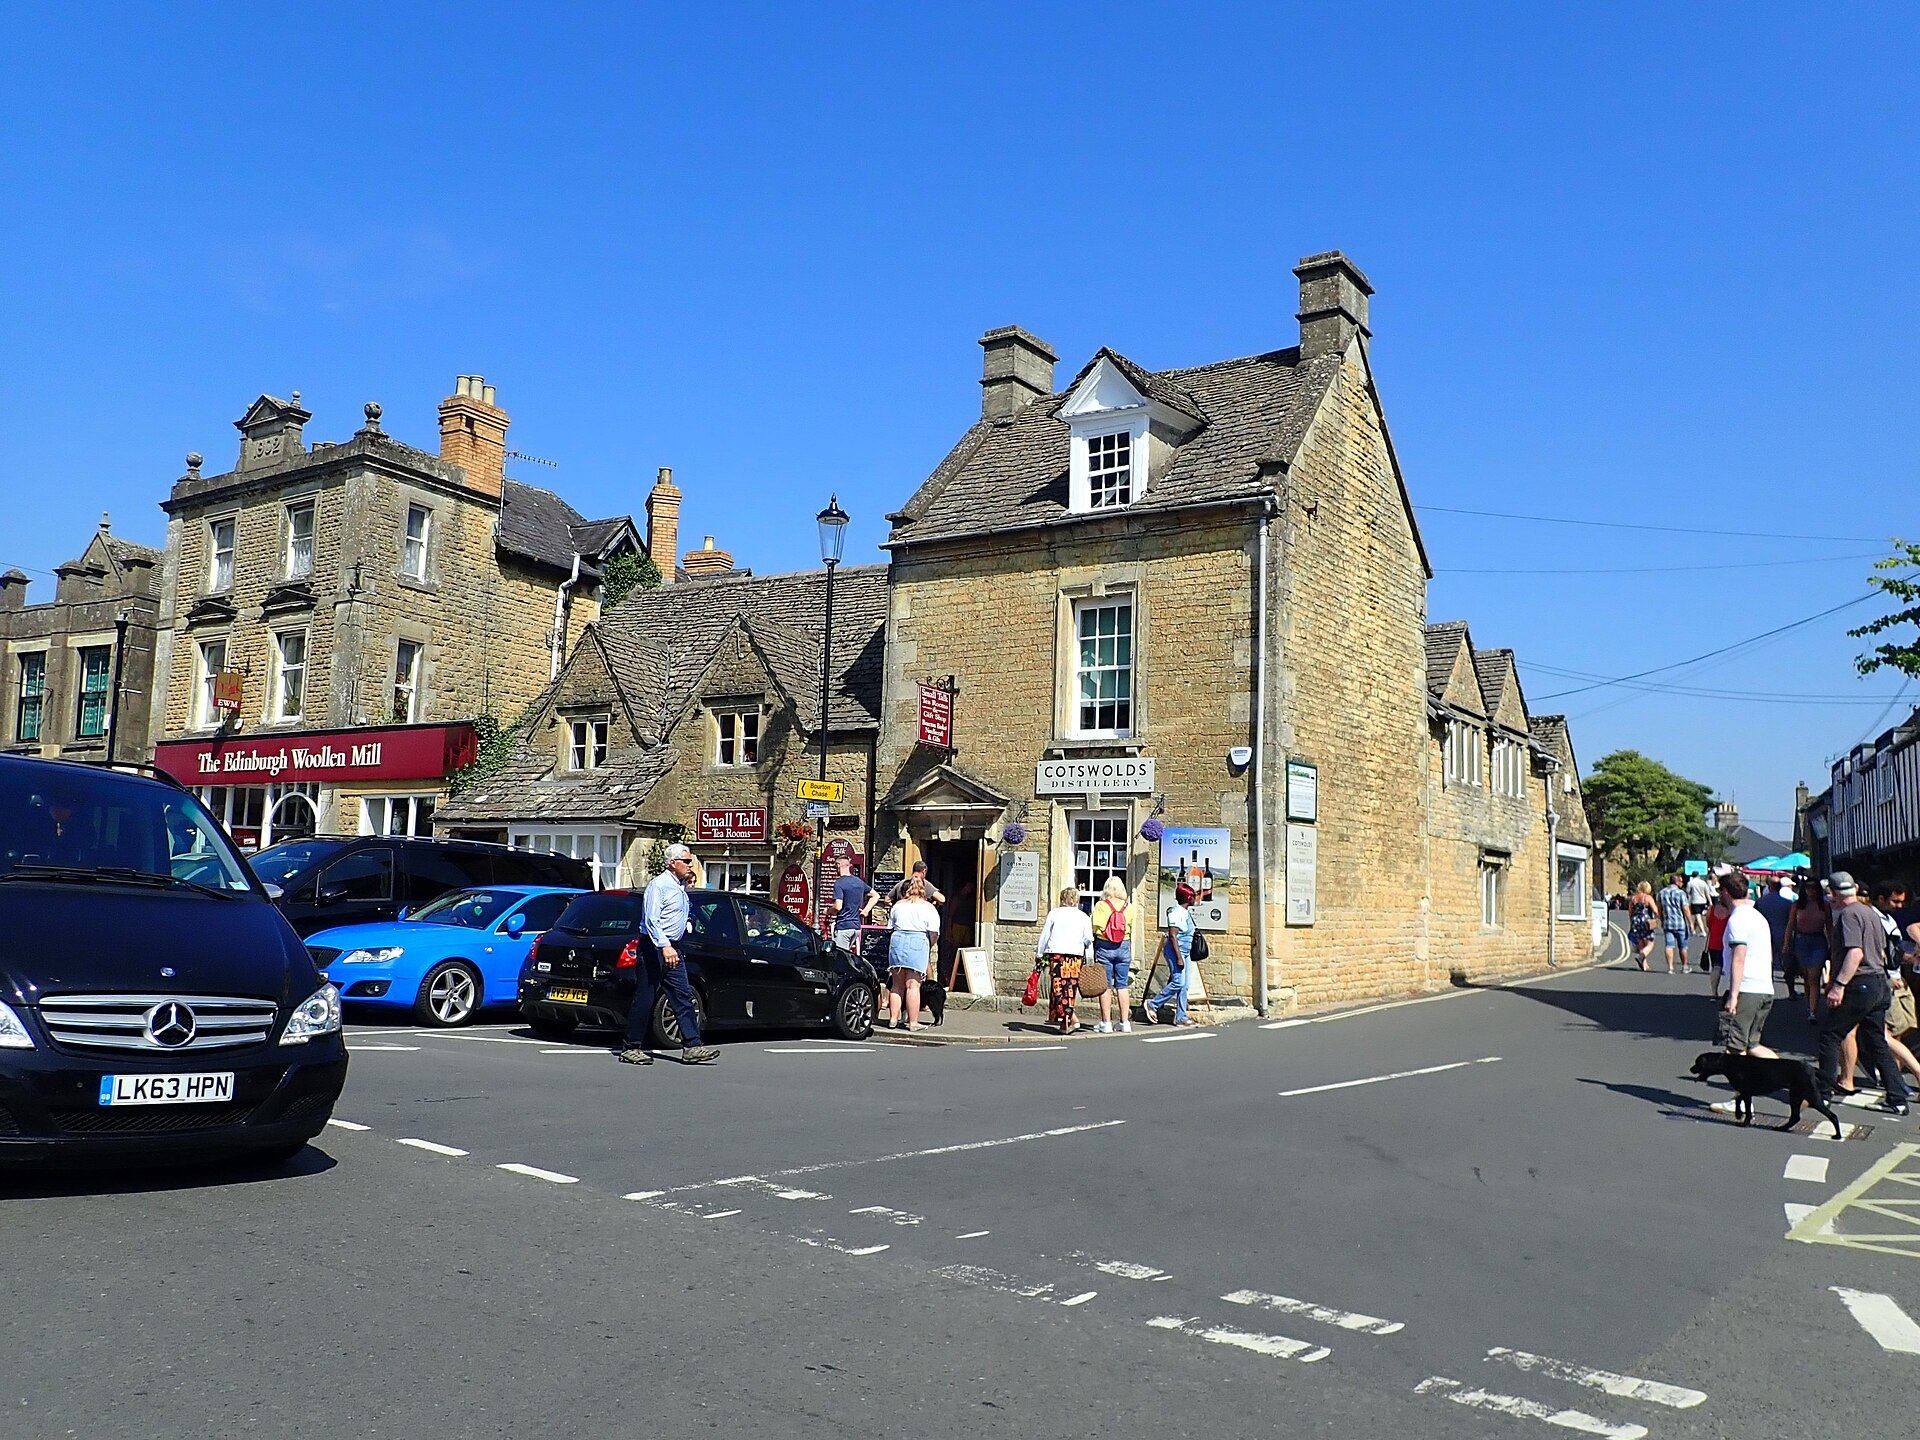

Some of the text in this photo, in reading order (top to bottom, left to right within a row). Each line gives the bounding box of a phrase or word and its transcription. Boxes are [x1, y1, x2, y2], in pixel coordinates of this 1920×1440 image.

[922, 688, 949, 702] Small Talk
[217, 699, 239, 708] EWM
[922, 697, 949, 709] Tea Rooms
[923, 711, 947, 723] Gift Shop
[198, 742, 382, 776] The Edinburgh Woollen Mill
[1044, 764, 1147, 778] COTSWOLDS
[810, 782, 831, 791] Bourton
[1051, 779, 1140, 788] DISTILLERY
[811, 789, 829, 798] Chase
[702, 812, 762, 828] Small Talk
[711, 828, 751, 838] Tea Rooms
[784, 874, 803, 882] Small
[786, 884, 802, 893] Talk
[783, 894, 804, 903] Cream
[786, 905, 801, 914] Teas
[116, 1076, 229, 1100] LK63 HPN
